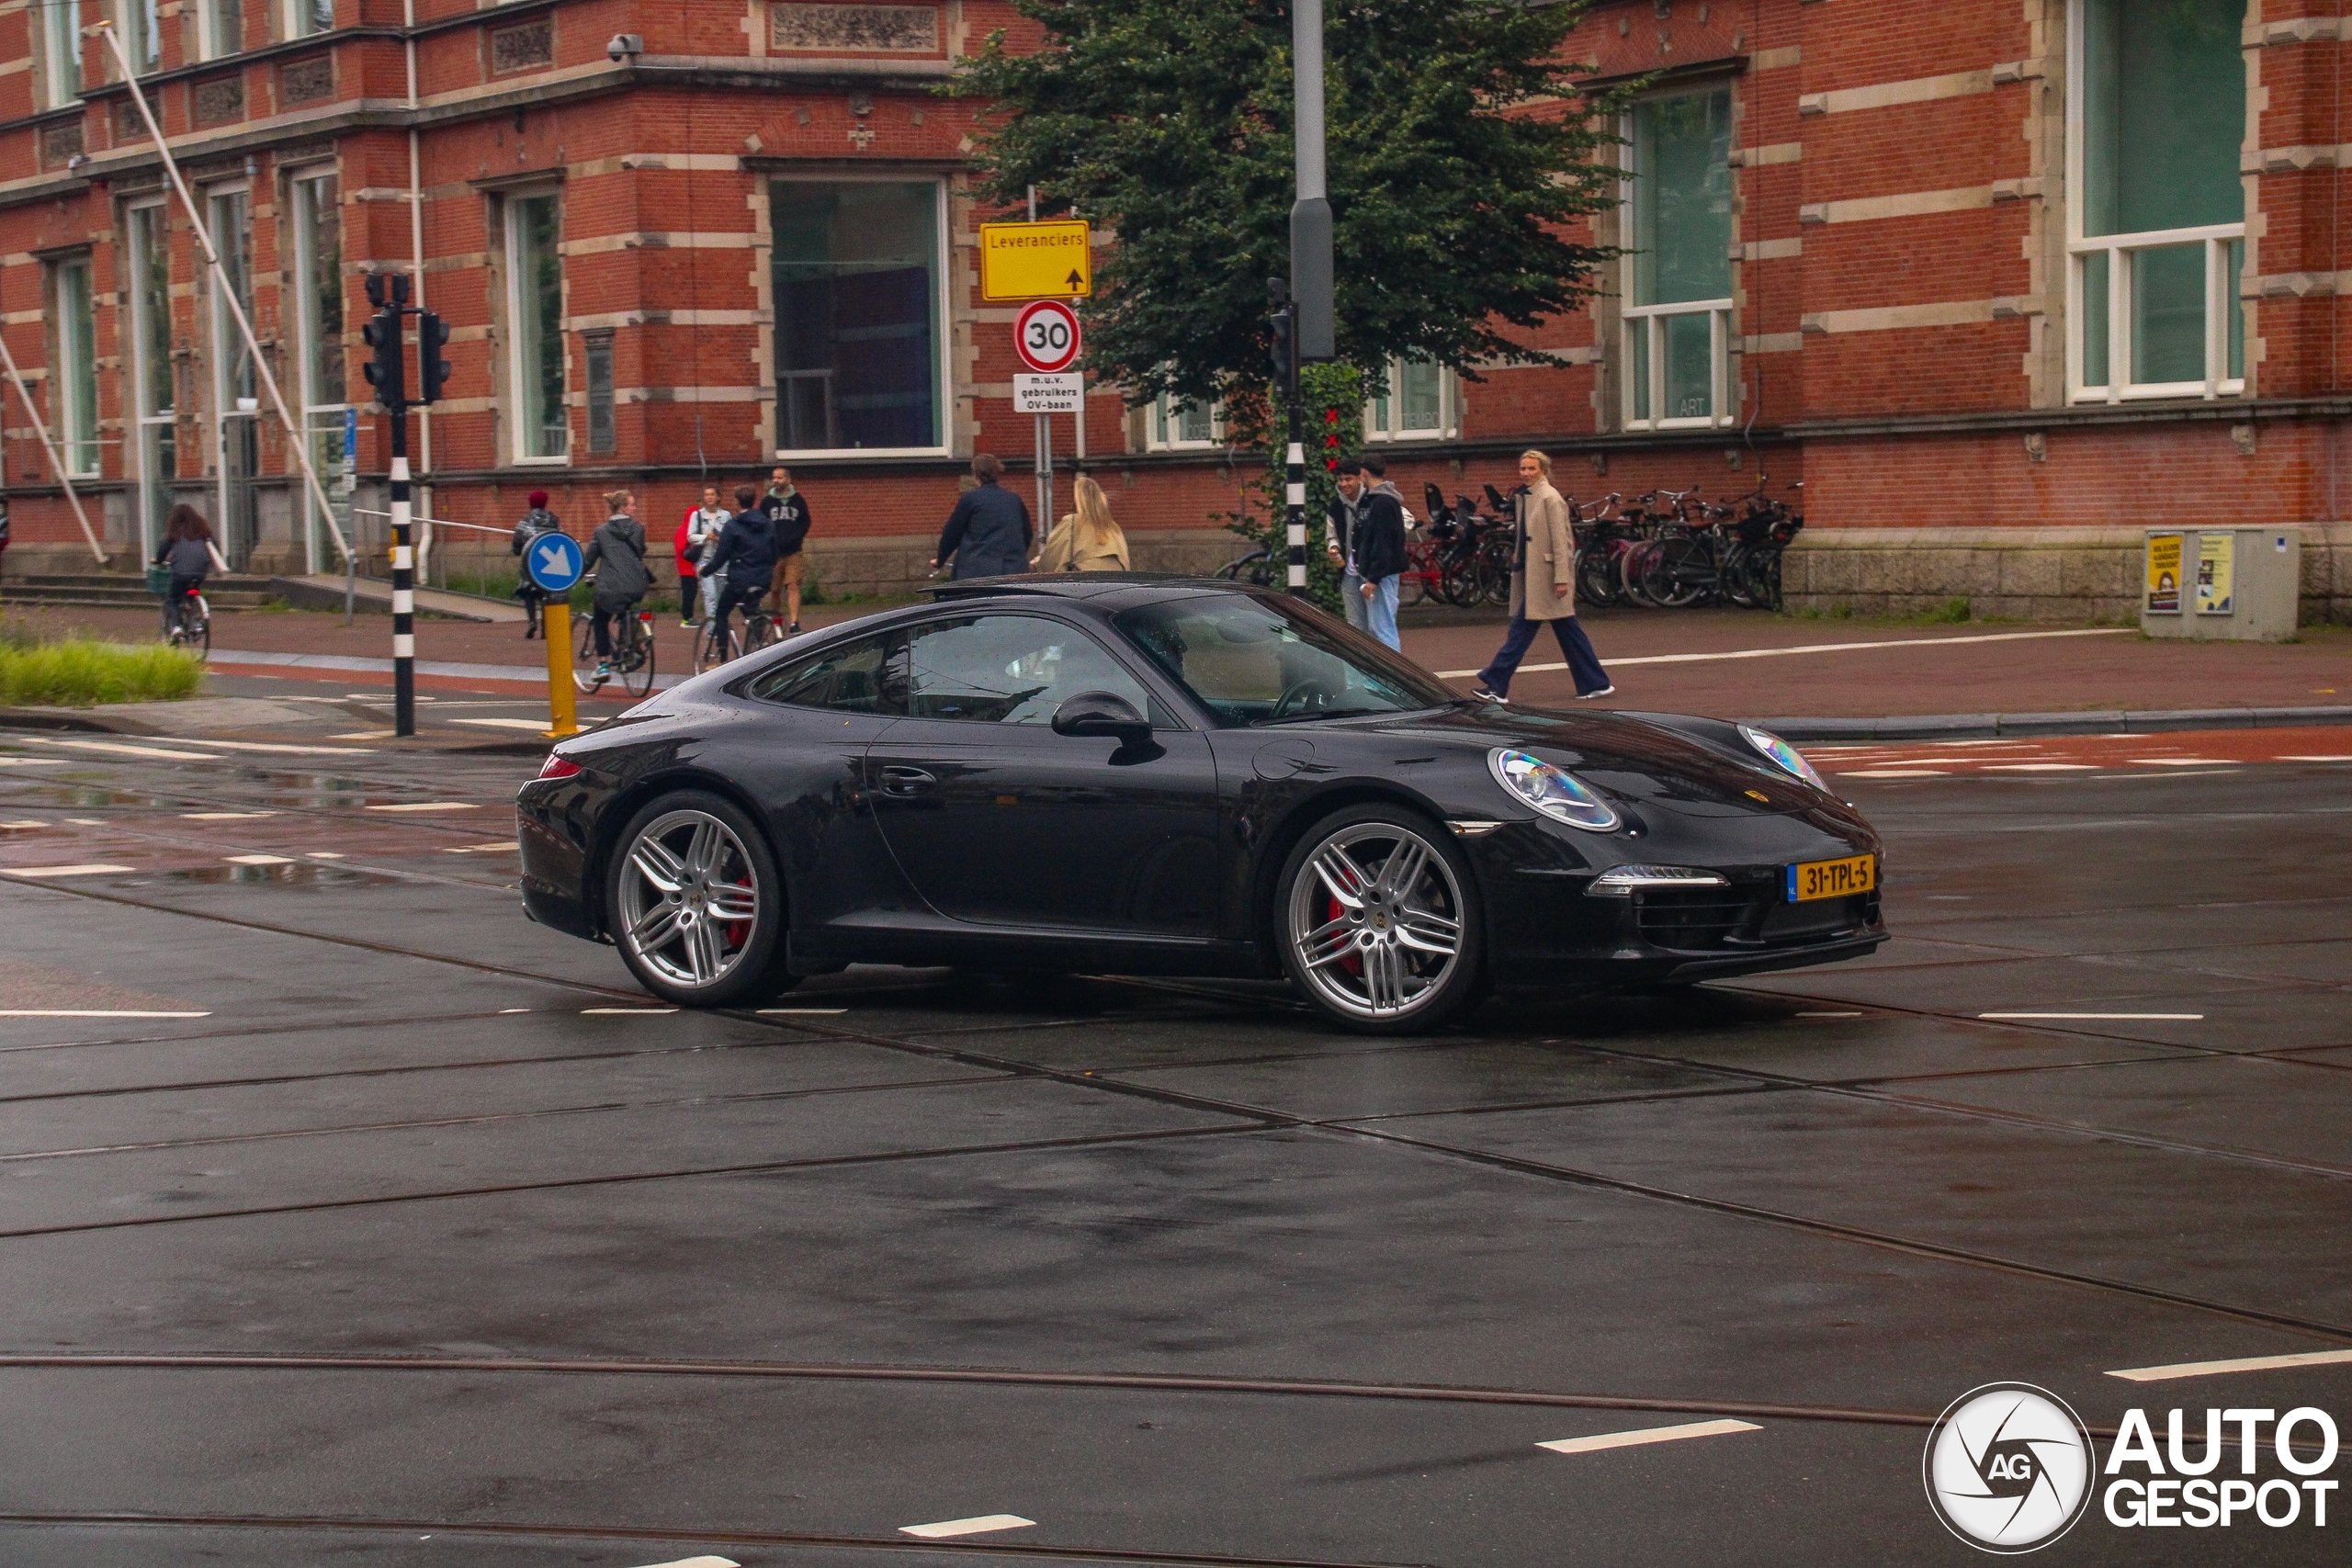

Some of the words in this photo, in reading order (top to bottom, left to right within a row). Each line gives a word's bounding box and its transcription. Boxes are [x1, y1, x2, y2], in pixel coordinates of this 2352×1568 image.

[991, 232, 1083, 249] Leveranciers
[1028, 322, 1069, 349] 30
[1022, 389, 1077, 399] gebruikers
[1027, 400, 1072, 409] OV-baan
[1680, 398, 1705, 416] ART
[769, 506, 799, 521] GAP
[1806, 861, 1868, 895] 31-TPL-5
